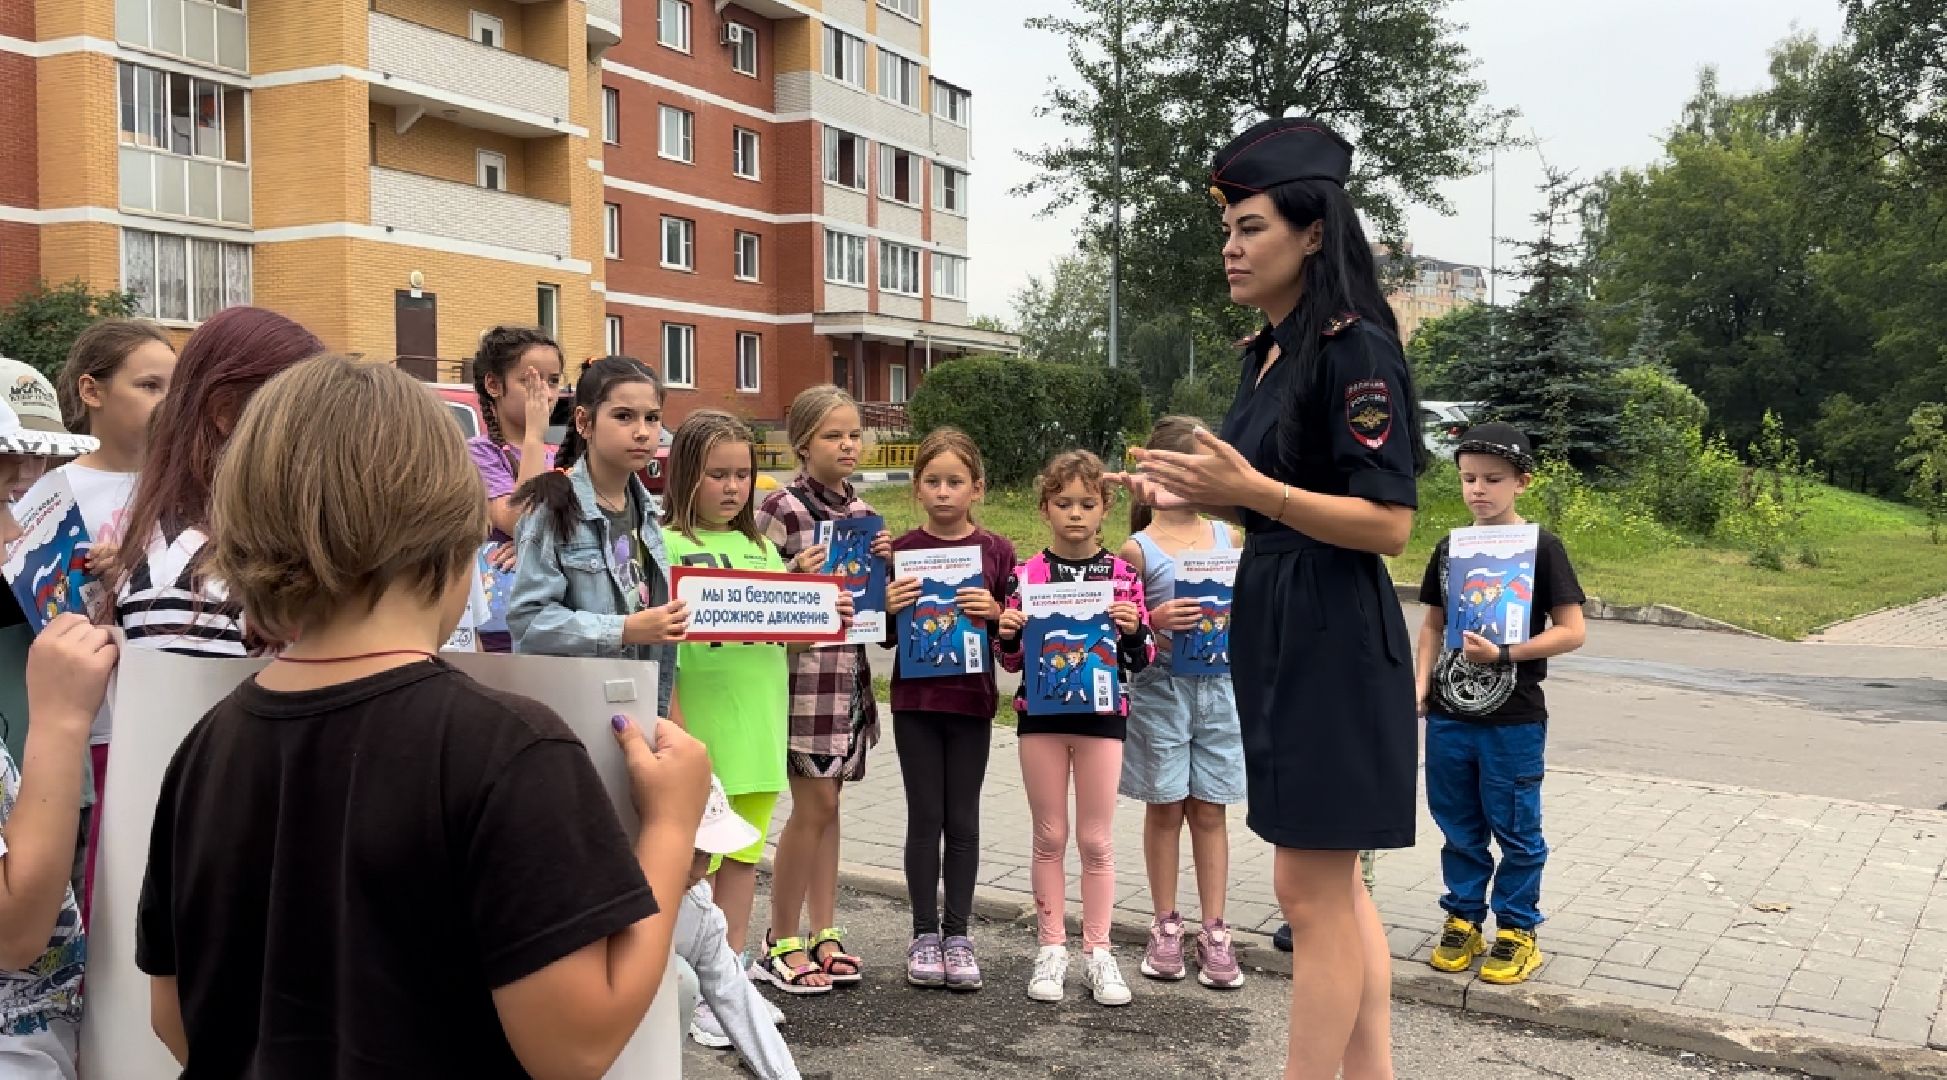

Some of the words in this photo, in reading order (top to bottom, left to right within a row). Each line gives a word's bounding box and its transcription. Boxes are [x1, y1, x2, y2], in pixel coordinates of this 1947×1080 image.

[727, 588, 742, 603] за
[745, 586, 821, 605] безопасное
[694, 609, 765, 627] дорожное
[767, 611, 830, 625] движение
